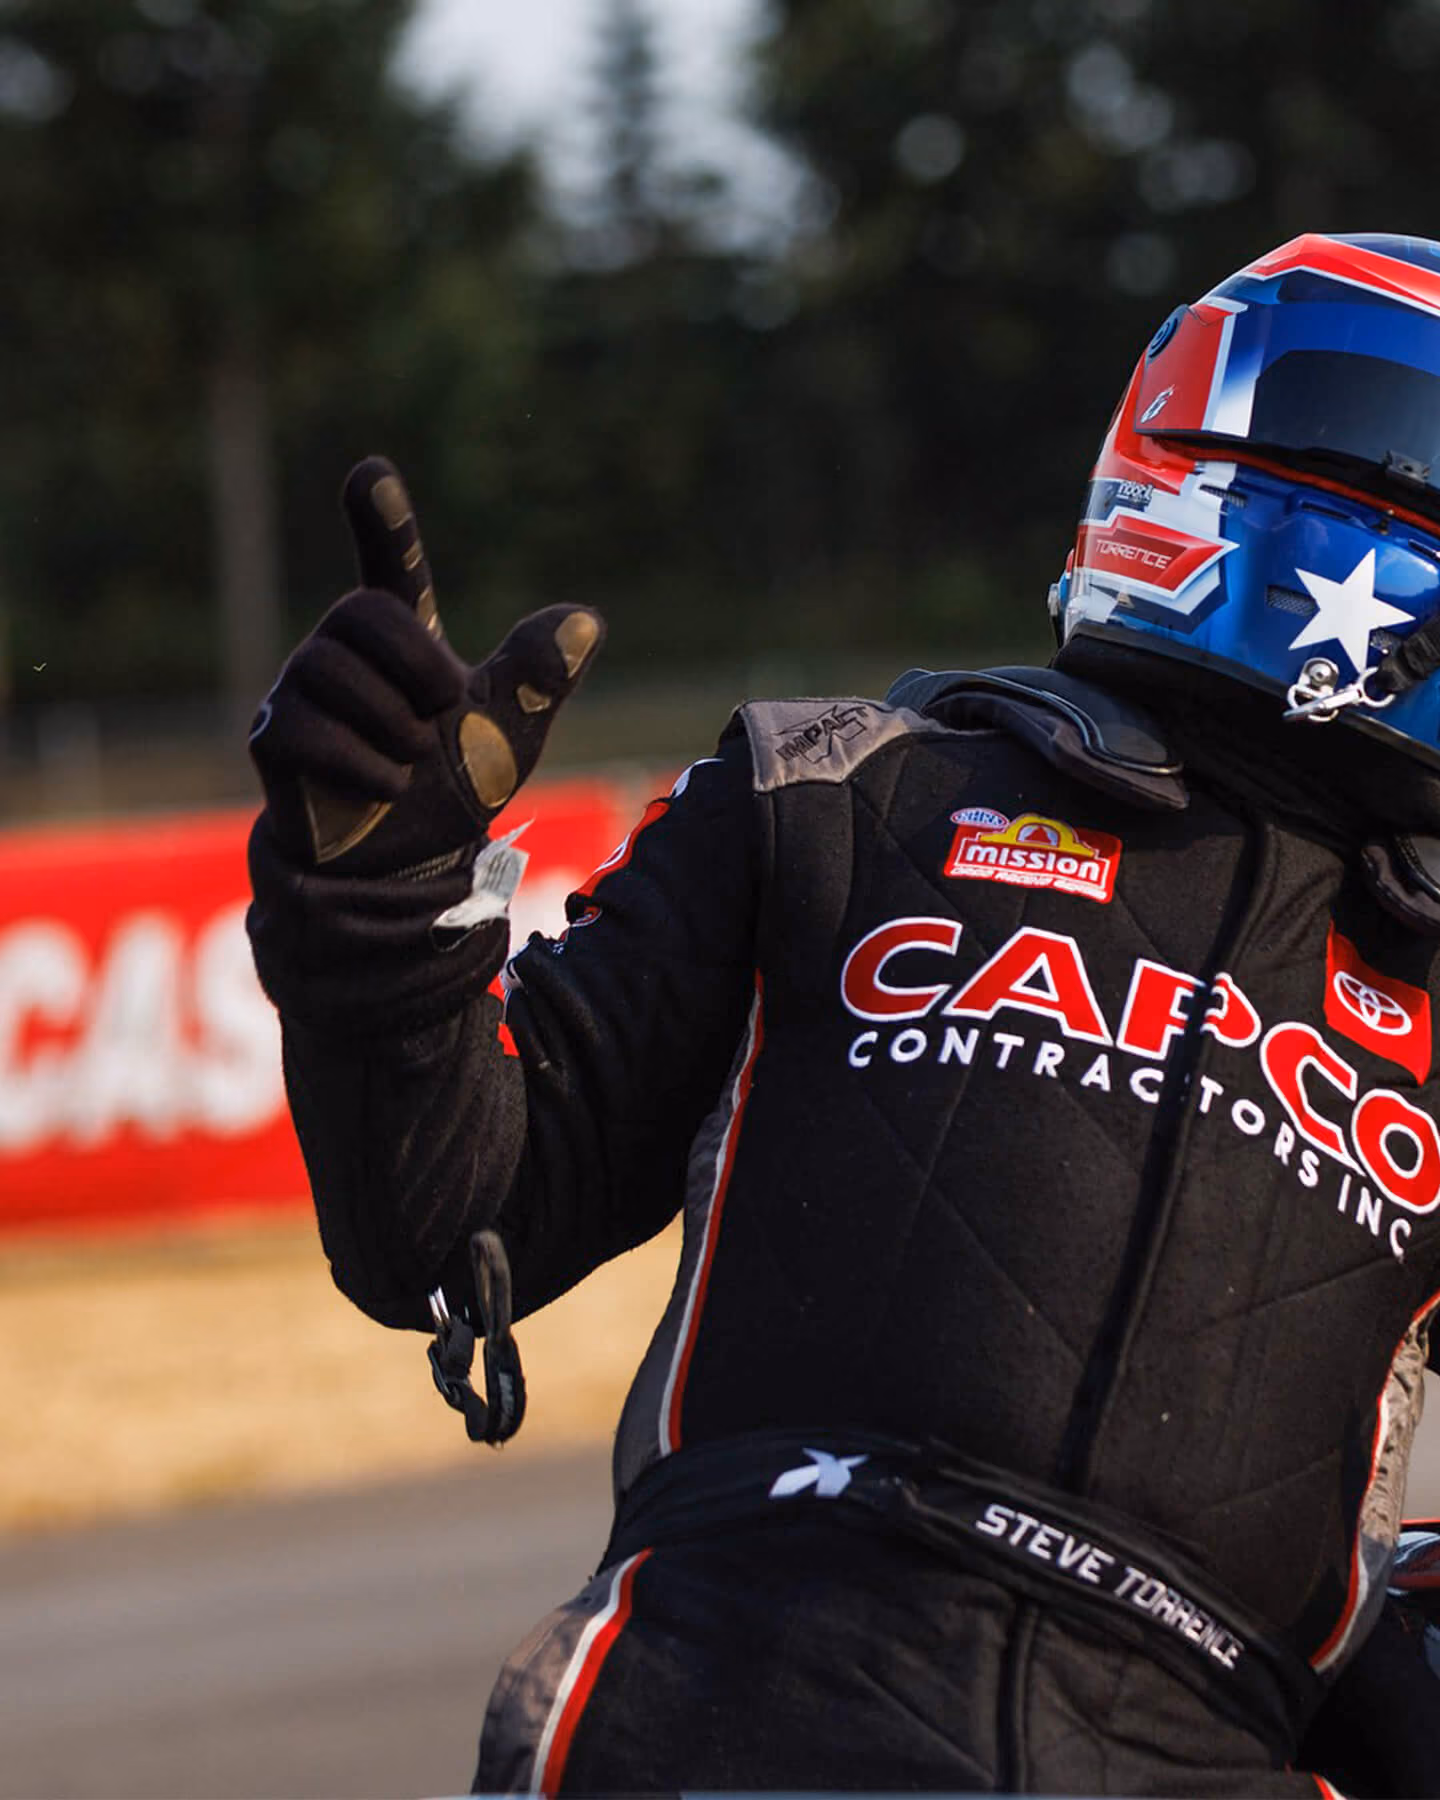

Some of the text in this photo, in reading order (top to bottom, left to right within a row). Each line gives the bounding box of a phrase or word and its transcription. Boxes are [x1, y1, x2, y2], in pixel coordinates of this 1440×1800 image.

[1096, 539, 1173, 570] TORRENCE
[848, 1026, 1412, 1260] CONTRACTORS INC
[975, 1503, 1245, 1670] STEVE TORRENCE
